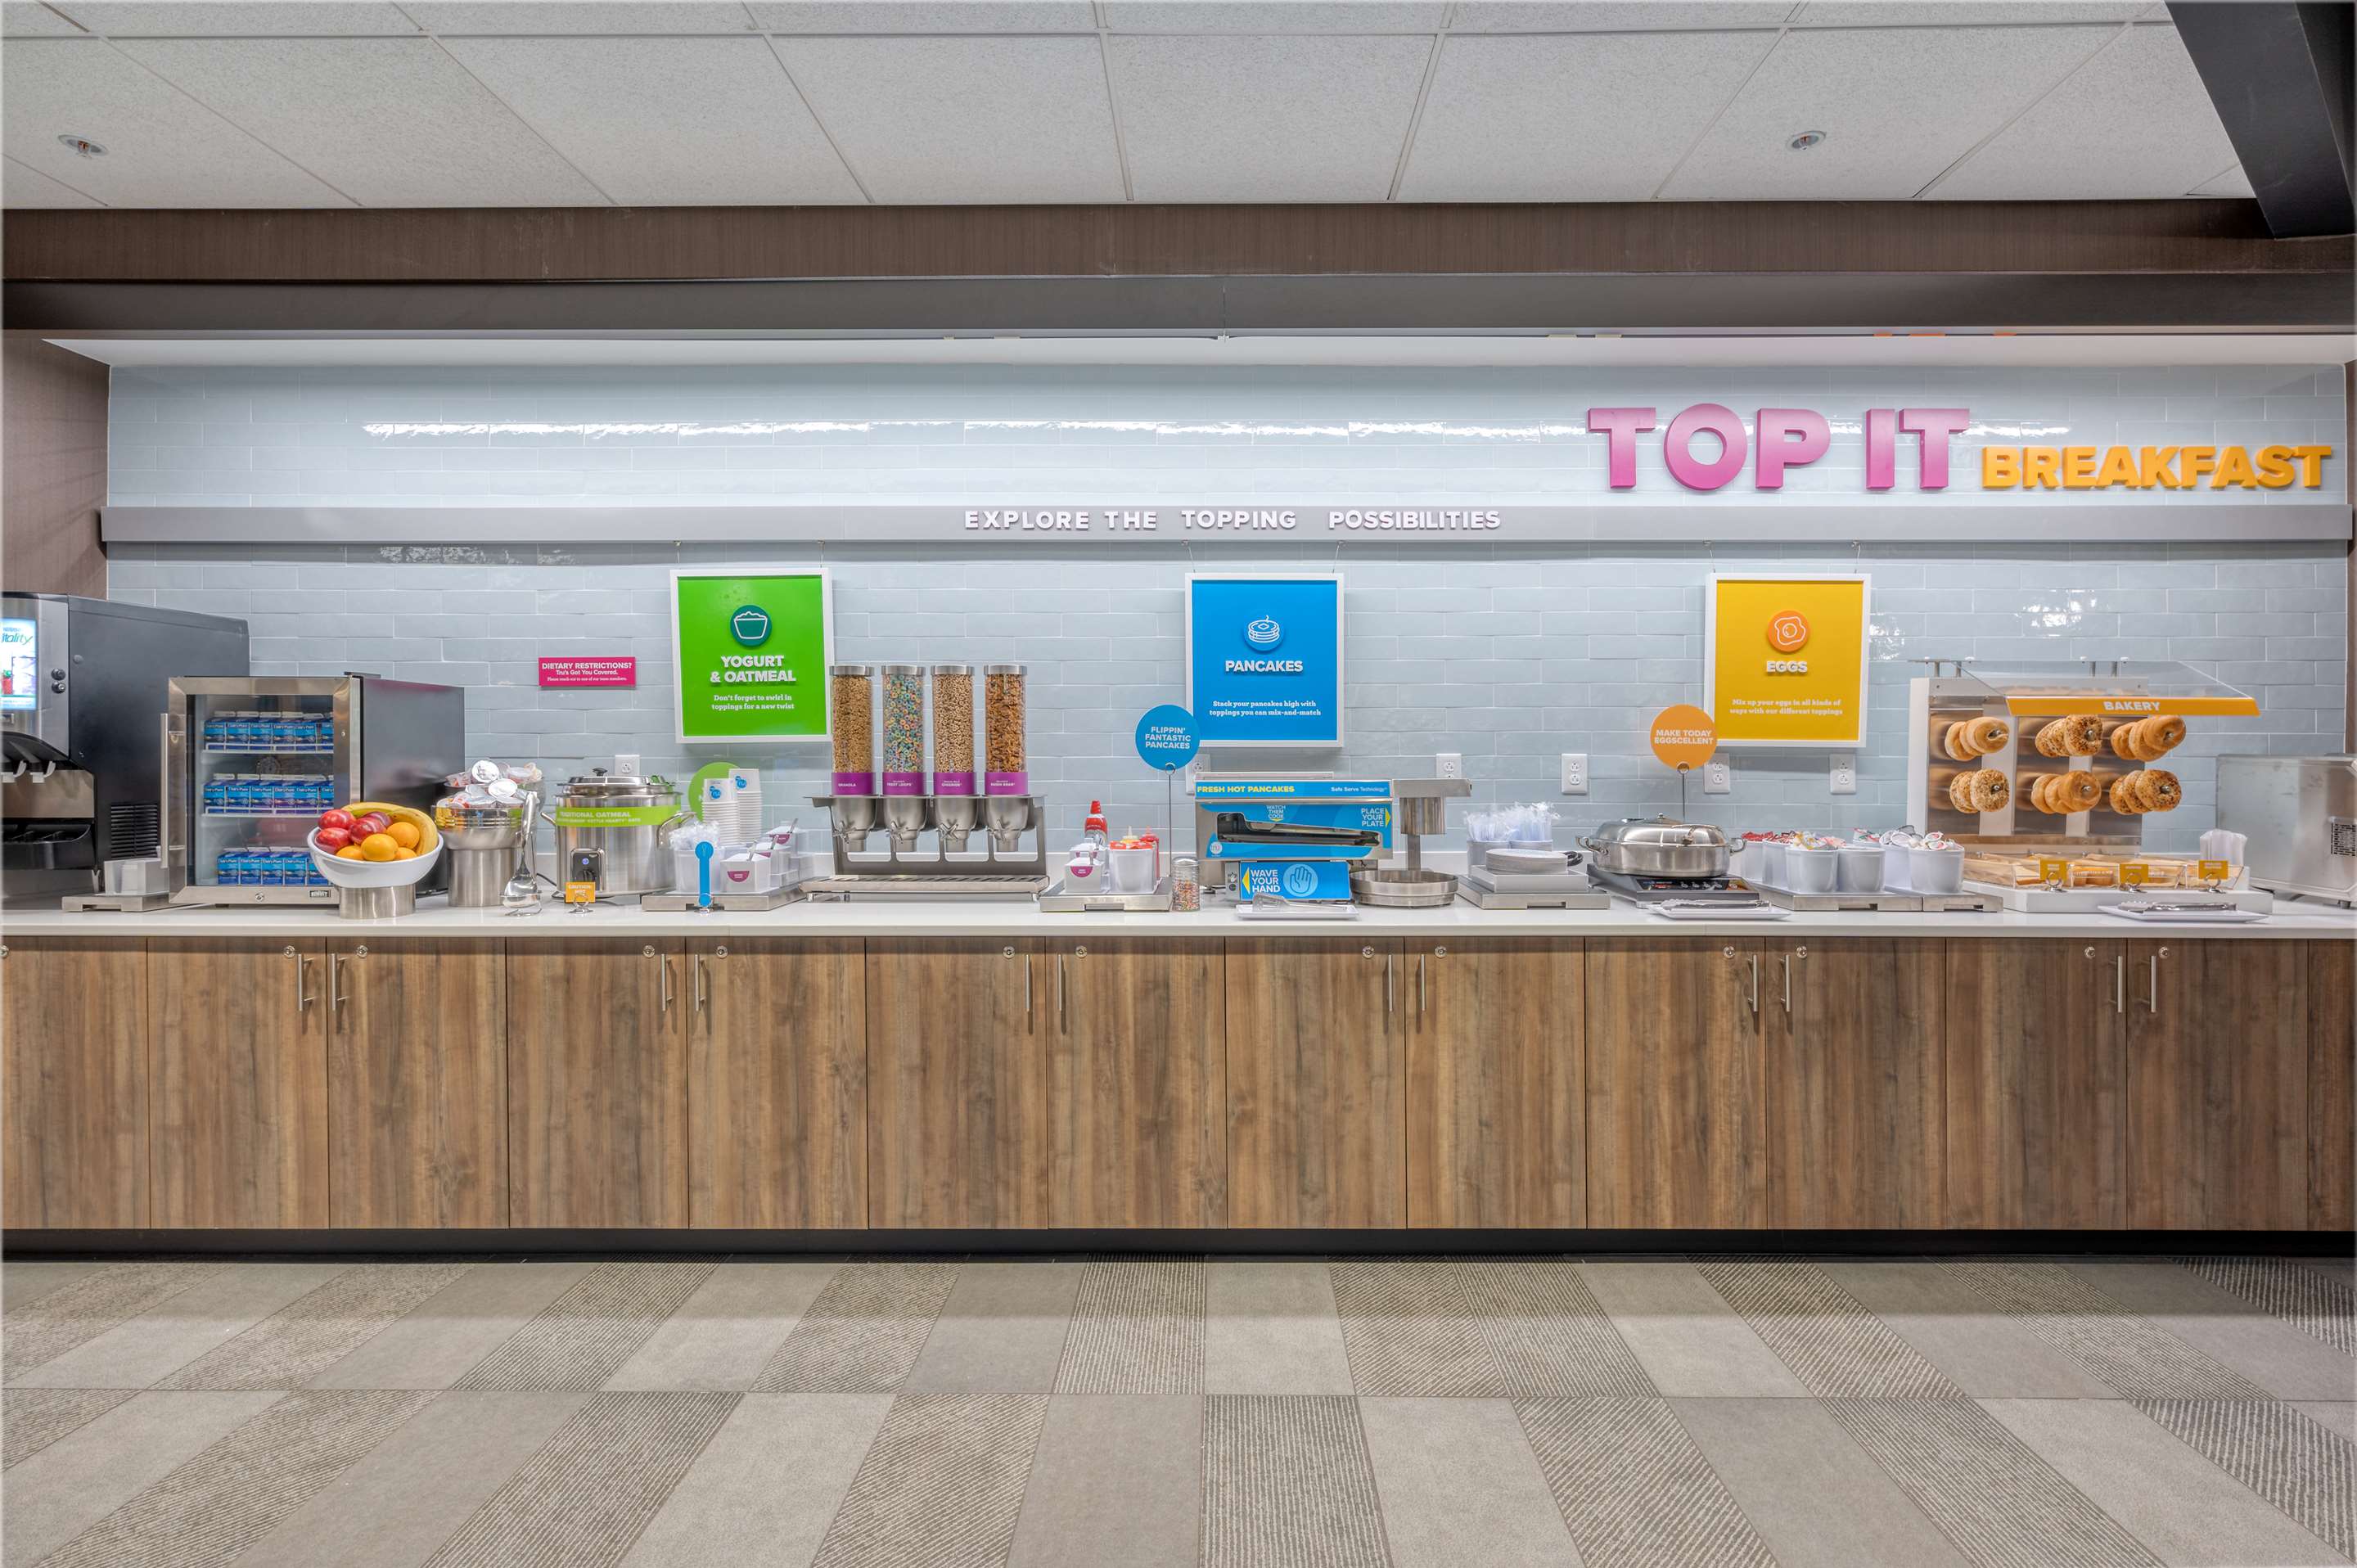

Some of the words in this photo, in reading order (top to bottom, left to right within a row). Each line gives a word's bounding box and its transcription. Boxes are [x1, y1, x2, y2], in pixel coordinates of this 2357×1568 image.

[1588, 403, 1831, 491] TOP
[1866, 408, 1970, 490] IT
[1981, 444, 2332, 491] BREAKFAST
[964, 509, 1090, 531] EXPLORE
[1105, 509, 1157, 530] THE
[1182, 508, 1296, 530] TOPPING
[1328, 508, 1501, 531] POSSIBILITIES
[2, 633, 34, 645] itality
[721, 655, 785, 668] YOGURT
[1225, 660, 1304, 673] PANCAKES
[1766, 660, 1808, 674] EGGS
[710, 672, 721, 683] &
[724, 670, 796, 683] OATMEAL
[734, 694, 756, 702] forget
[2103, 701, 2161, 711] BAKERY
[1145, 733, 1192, 741] FANTASTIC
[1655, 737, 1714, 745] EGGSCELLENT
[1146, 741, 1191, 750] PANCAKES
[1251, 885, 1281, 893] HAND
